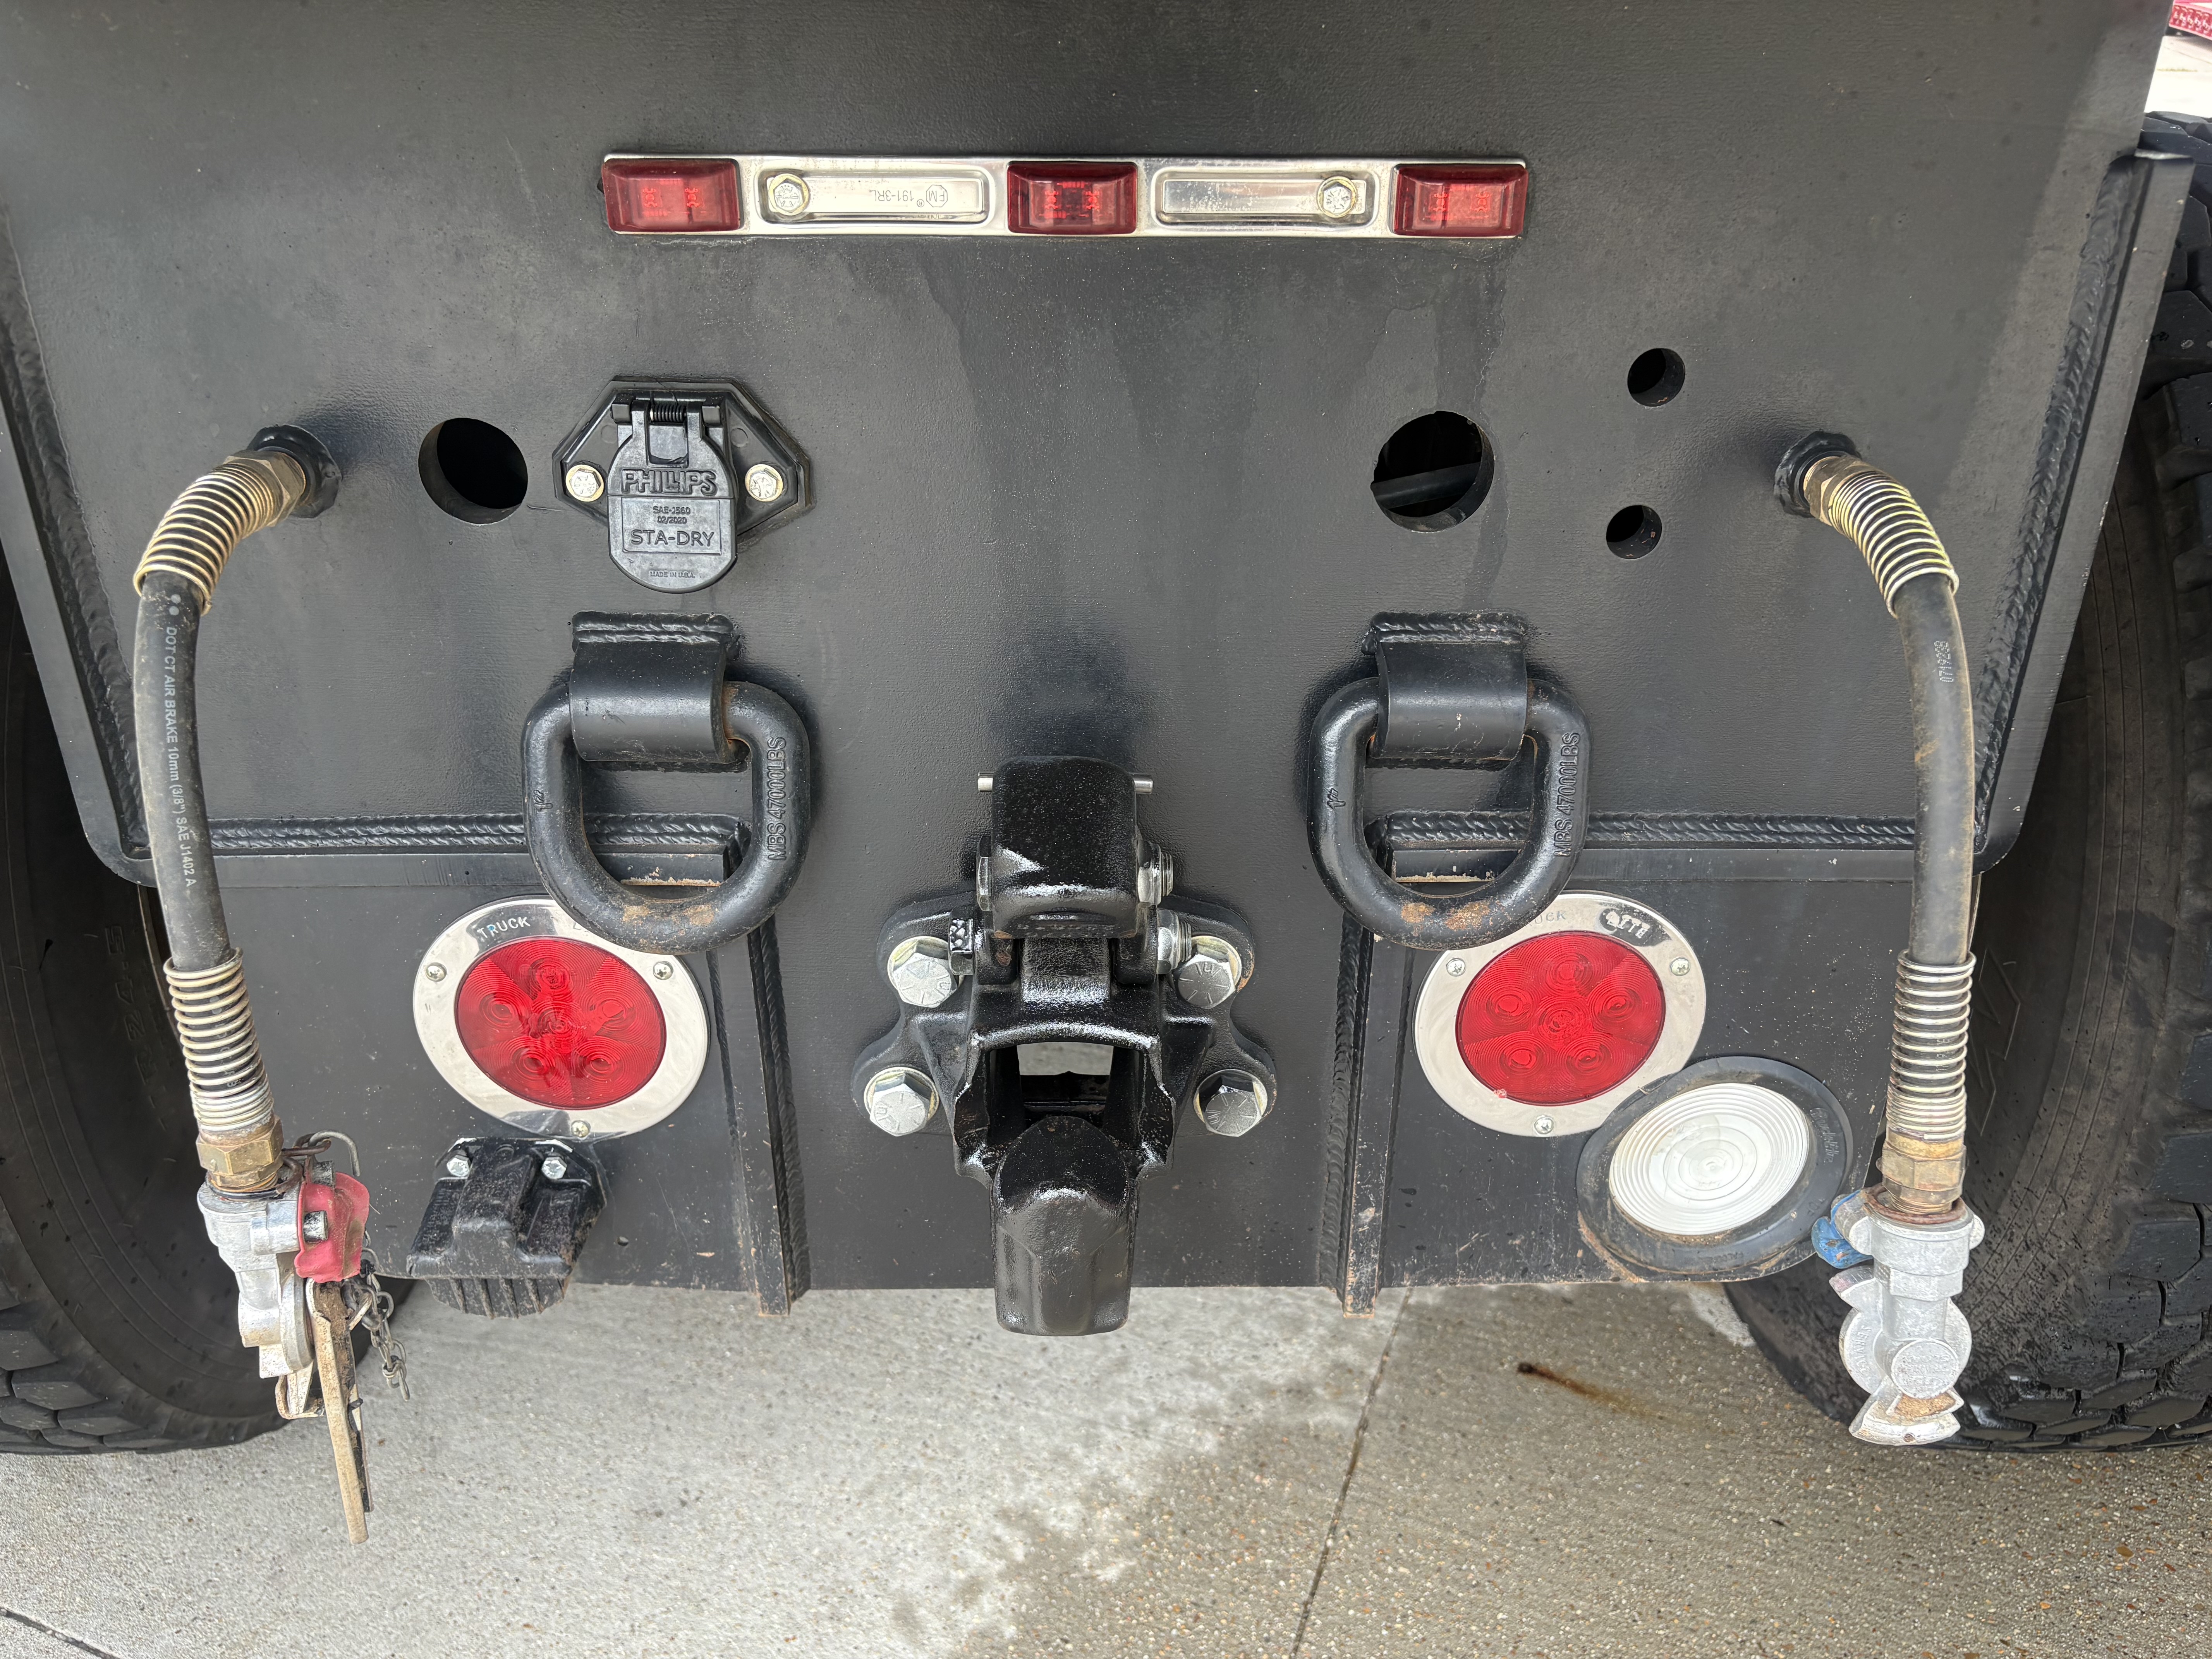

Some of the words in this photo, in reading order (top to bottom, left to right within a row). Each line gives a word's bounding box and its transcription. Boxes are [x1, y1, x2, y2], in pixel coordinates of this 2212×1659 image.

[869, 190, 914, 202] 191-3RL
[621, 468, 718, 496] PHILLIPS
[656, 515, 687, 525] 02/2020
[630, 529, 715, 547] STA-DRY
[165, 627, 178, 654] DOT
[164, 656, 176, 673] CT
[164, 675, 176, 697] AIR
[165, 700, 178, 744] BRAKE
[168, 747, 180, 781] 10mm
[169, 784, 186, 814] (3/8")
[176, 817, 190, 841] SAE
[1553, 819, 1573, 857] MBS
[767, 823, 787, 861] MBS
[179, 844, 195, 876] J1402
[185, 878, 197, 887] A
[477, 917, 531, 938] TRUCK
[1525, 910, 1566, 928] UCK
